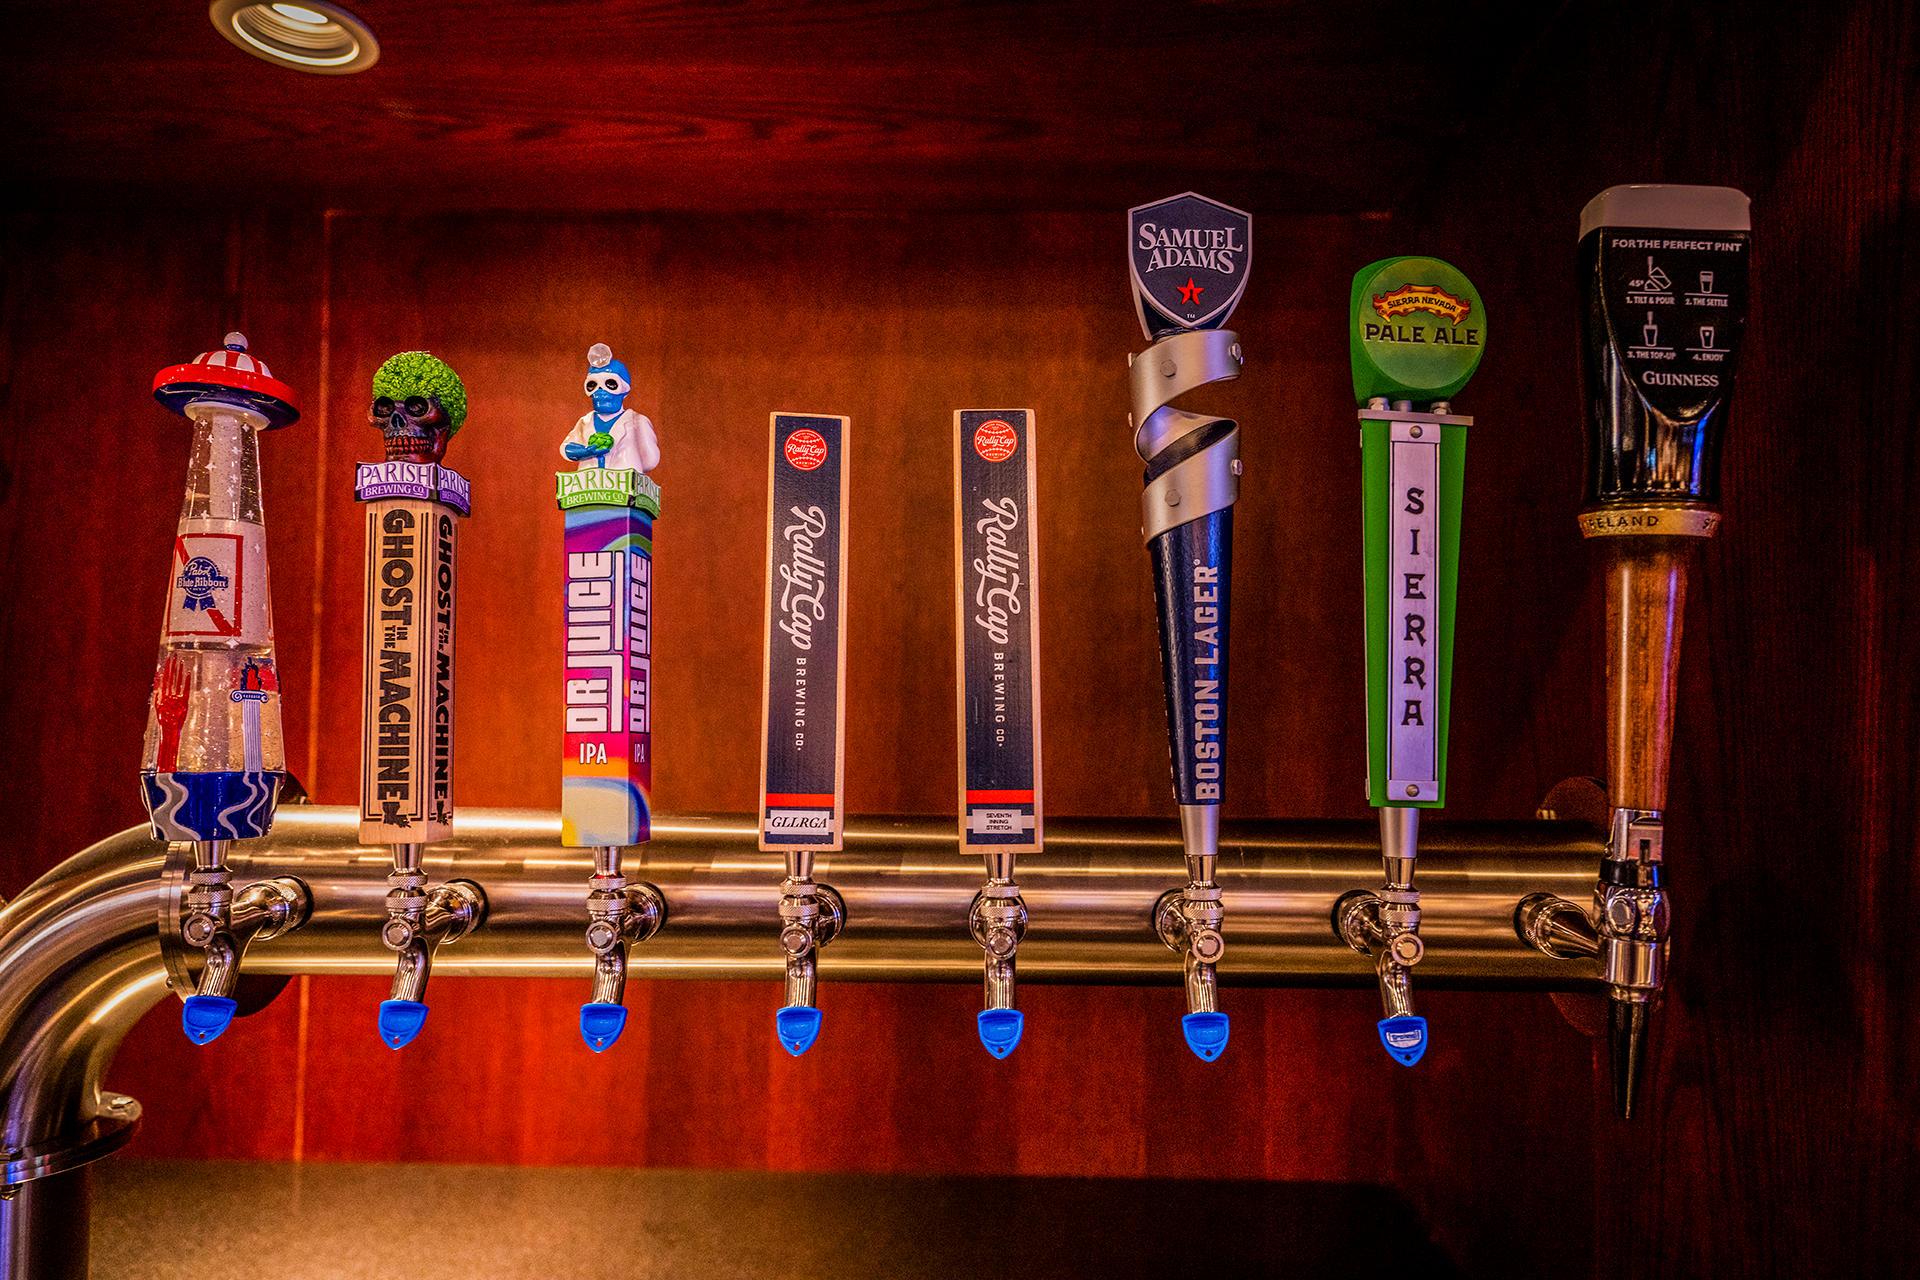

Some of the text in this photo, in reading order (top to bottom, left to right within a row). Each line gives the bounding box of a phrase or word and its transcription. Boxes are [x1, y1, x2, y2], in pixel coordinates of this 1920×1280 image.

[1138, 222, 1243, 252] SAMUEL
[1612, 239, 1742, 252] FOR THE PERFECT PINT
[1145, 248, 1235, 274] ADAMS
[1387, 296, 1457, 312] SIERRA NEVADA
[1655, 297, 1675, 305] POUR
[1693, 298, 1706, 306] THE
[1706, 299, 1729, 307] SETTLE
[1364, 323, 1480, 347] PALE ALE
[1636, 351, 1650, 359] THE
[1650, 351, 1677, 360] TOP-UP
[1642, 371, 1720, 387] GUINNESS
[787, 444, 825, 457] Rally Cap
[977, 435, 1015, 447] Rally Cap
[360, 462, 434, 489] PARISH
[439, 467, 470, 504] PARISH
[560, 469, 630, 496] PARISH
[365, 485, 411, 497] BREWING
[566, 491, 611, 505] BREWING
[779, 506, 826, 611] Rally
[974, 497, 1019, 606] Rally
[178, 576, 226, 588] Blue Ribbon
[186, 562, 214, 578] Pabst
[437, 514, 453, 629] GHOST
[779, 579, 825, 651] Cap
[975, 573, 1021, 644] Cap
[1400, 487, 1427, 726] SIERRA
[378, 509, 415, 801] GHOST IN THE MACHINE
[565, 550, 626, 734] DR JUICE
[629, 551, 651, 734] DR JUICE
[795, 657, 807, 751] BREWING CO.
[993, 652, 1005, 747] BREWING CO.
[435, 650, 450, 800] MACHINE
[579, 742, 608, 764] IPA
[634, 742, 645, 763] IPA
[1194, 680, 1220, 801] BOSTON
[771, 815, 828, 829] GLLRGA
